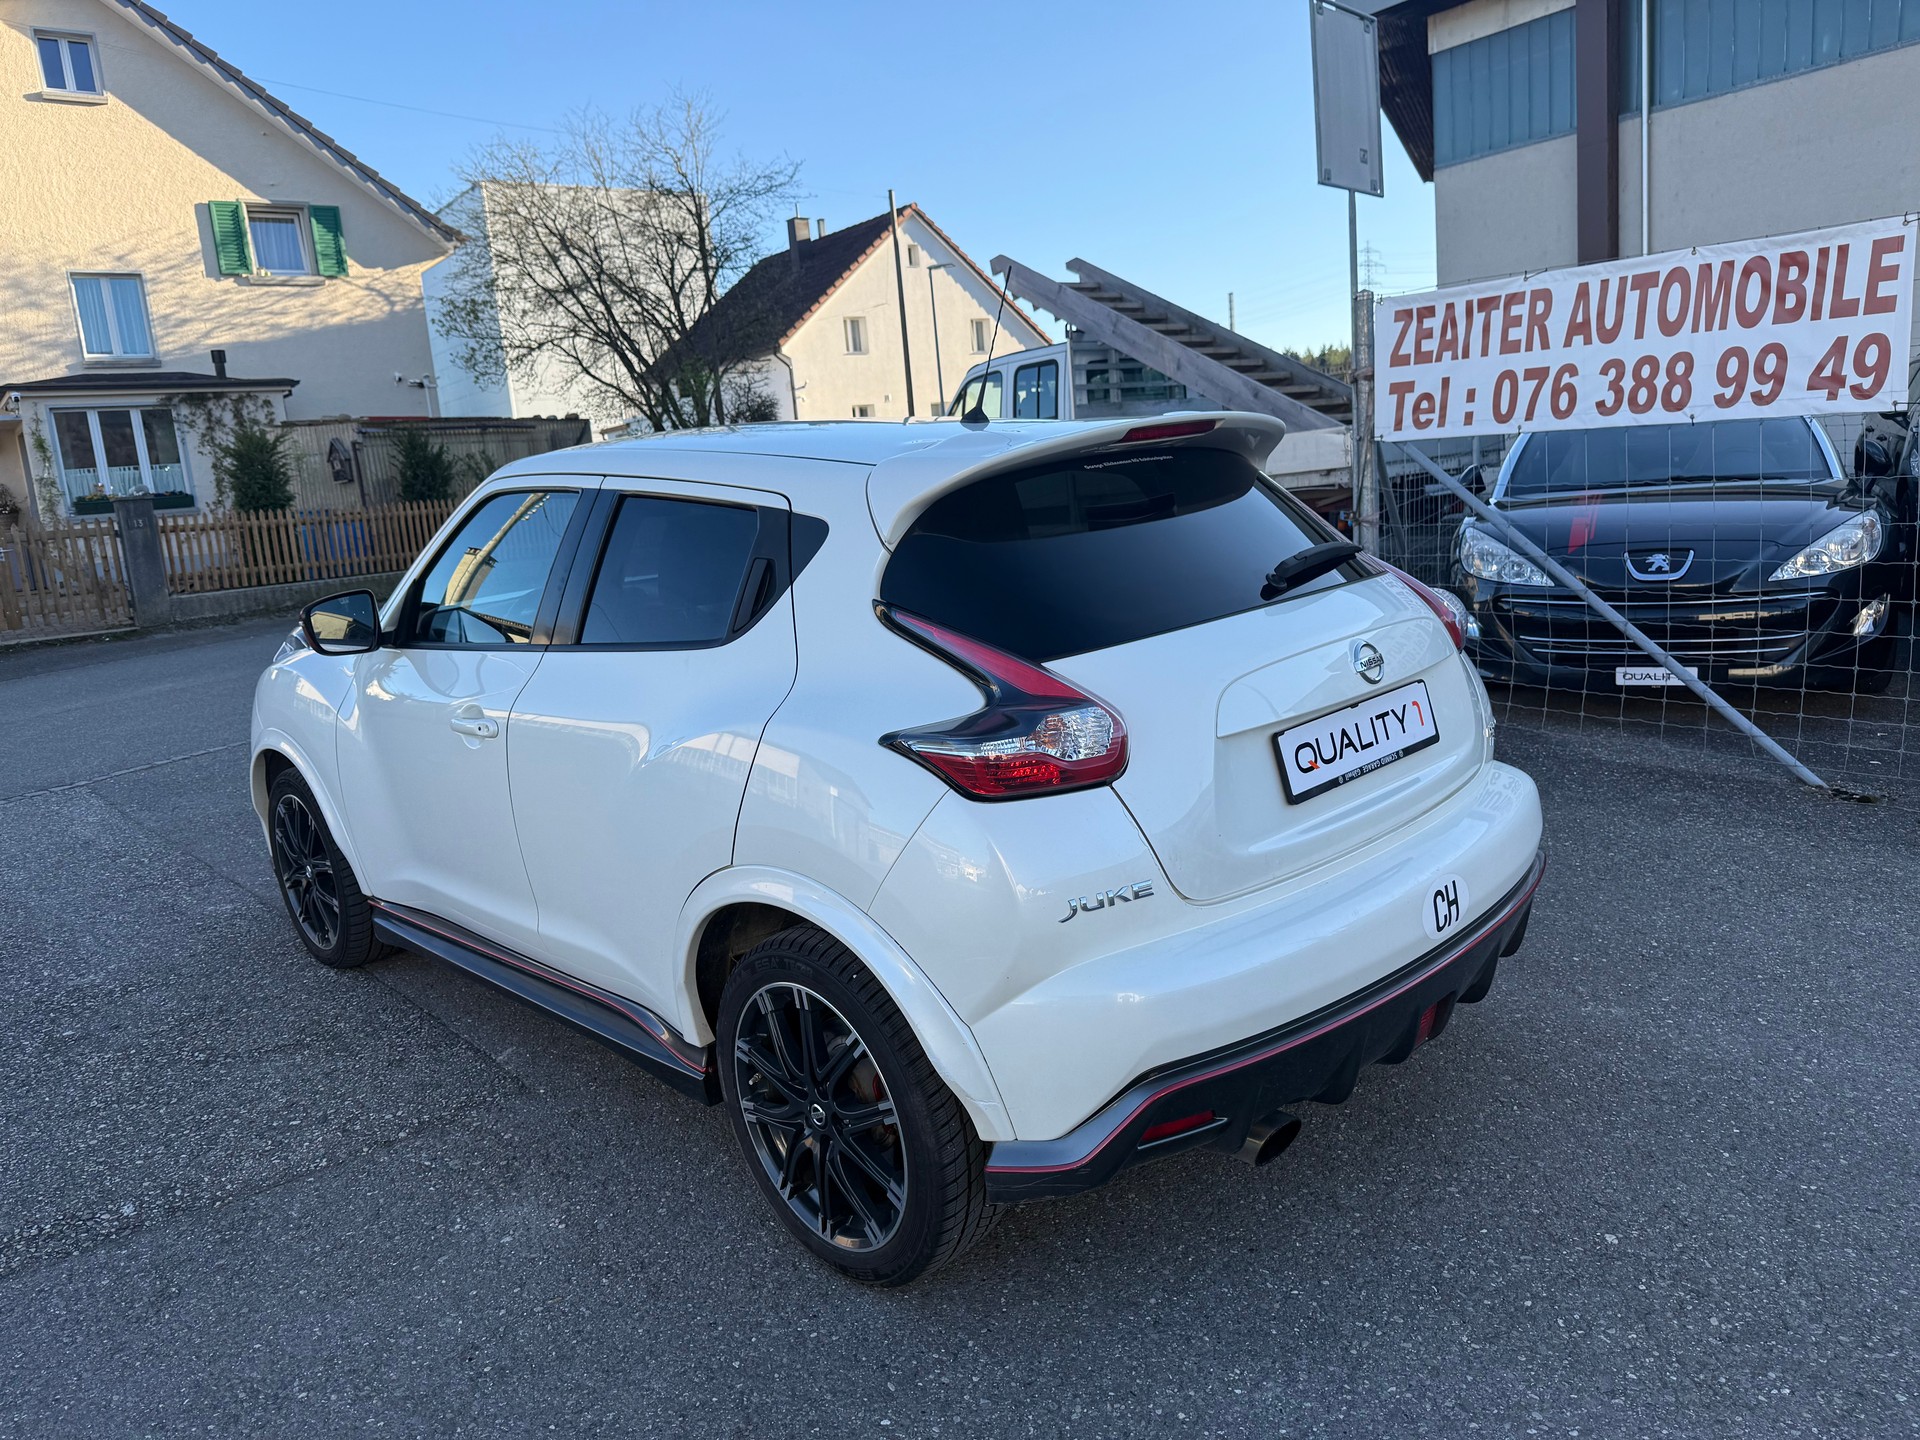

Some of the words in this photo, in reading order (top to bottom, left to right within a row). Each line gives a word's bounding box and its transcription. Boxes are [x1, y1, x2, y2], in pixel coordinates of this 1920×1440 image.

[1389, 287, 1552, 367] ZEAITER
[1563, 235, 1905, 348] AUTOMOBILE
[1492, 363, 1579, 424] 076
[1596, 352, 1694, 416] 388
[1714, 342, 1788, 409] 99
[1807, 332, 1892, 401] 49
[133, 519, 144, 528] 13
[1622, 672, 1682, 681] QUALIT
[1058, 879, 1154, 923] JUKE
[1432, 879, 1460, 933] CH
